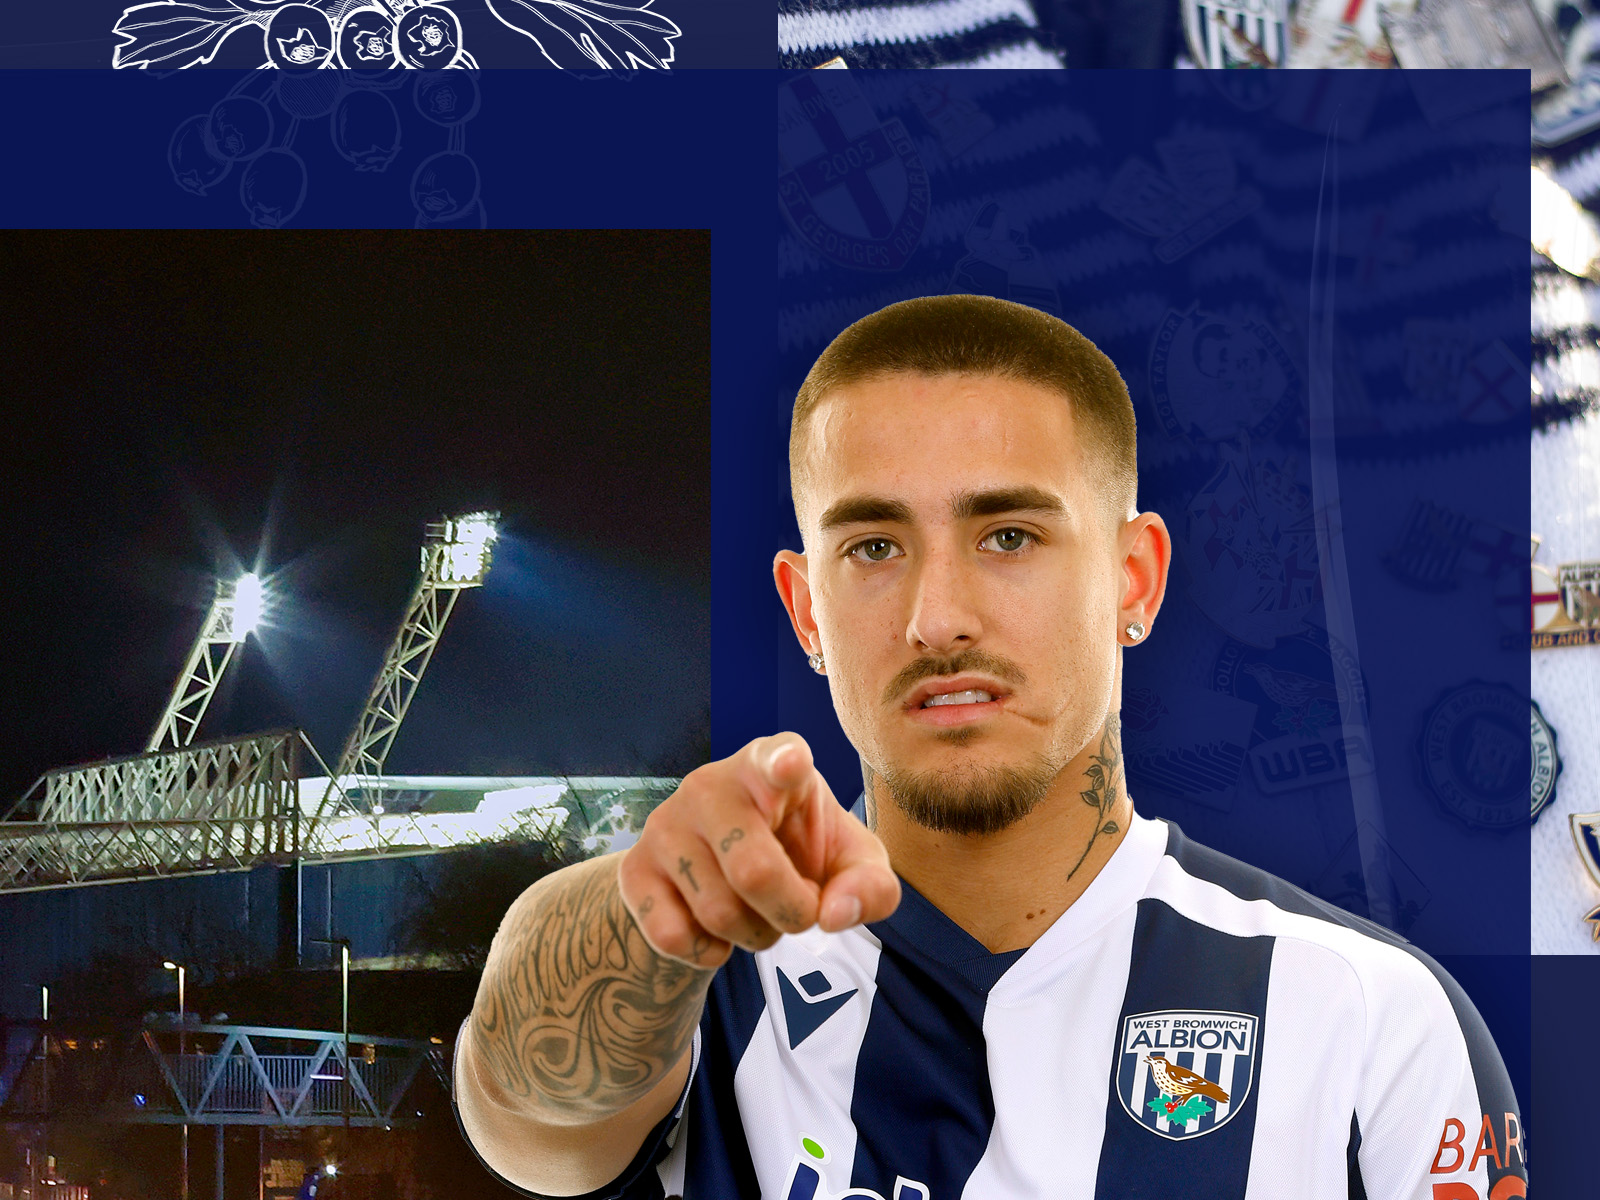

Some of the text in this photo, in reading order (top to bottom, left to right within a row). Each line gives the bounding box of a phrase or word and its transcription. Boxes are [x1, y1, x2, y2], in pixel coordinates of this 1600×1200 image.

[818, 140, 877, 183] 2005
[1129, 1029, 1247, 1052] ALBION
[1133, 1019, 1248, 1031] WEST BROMWICH
[1430, 1112, 1527, 1175] BAR
